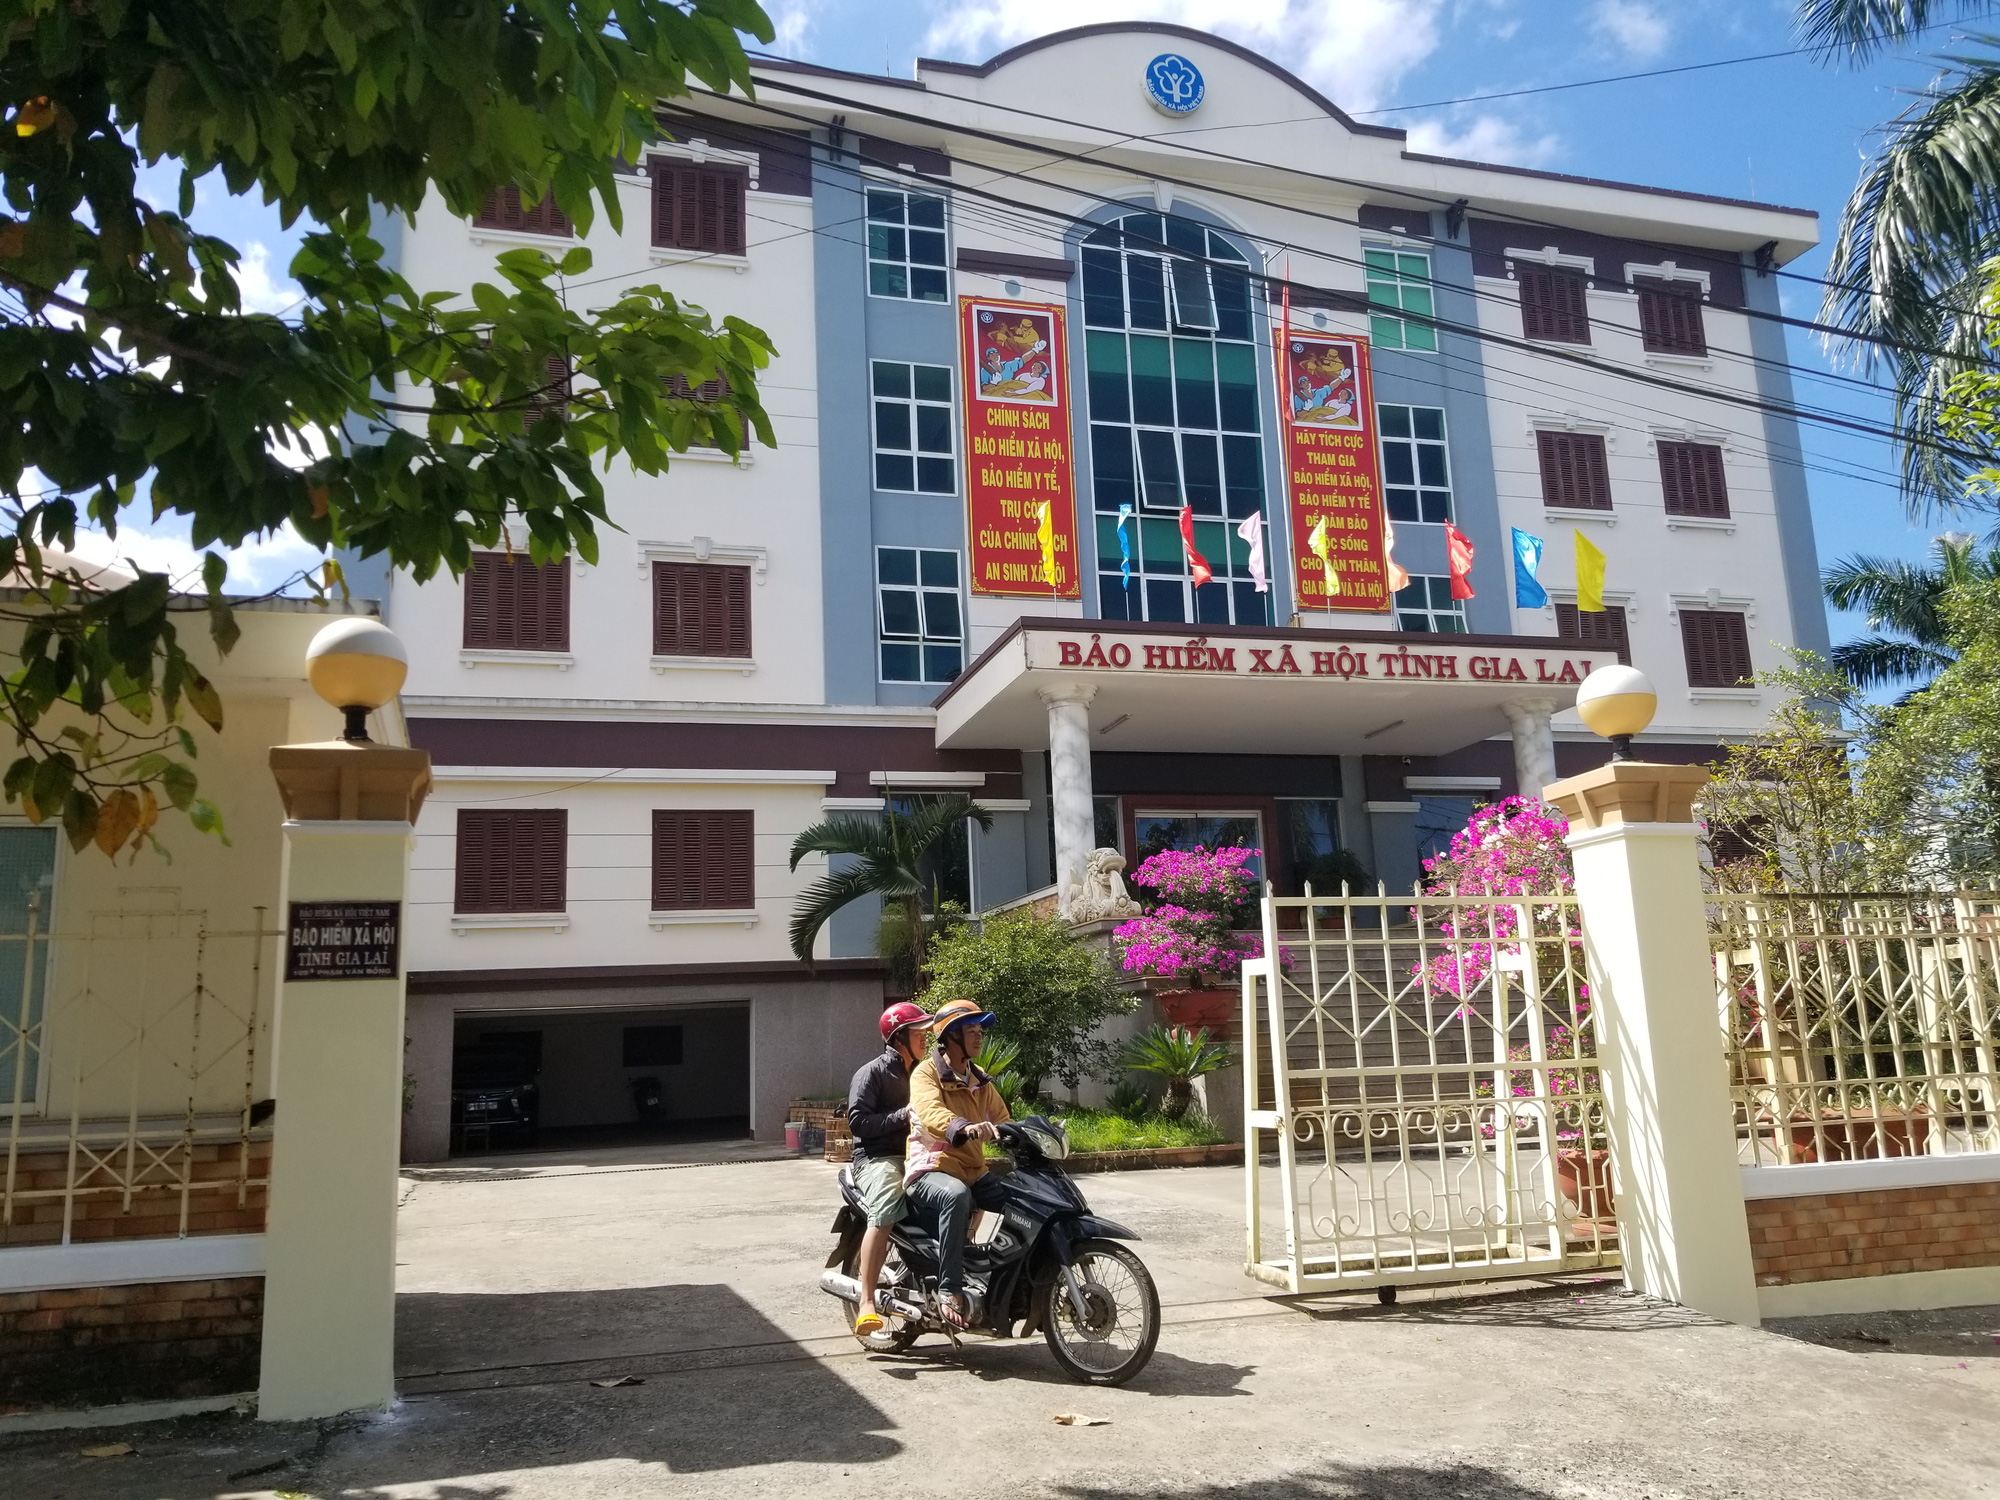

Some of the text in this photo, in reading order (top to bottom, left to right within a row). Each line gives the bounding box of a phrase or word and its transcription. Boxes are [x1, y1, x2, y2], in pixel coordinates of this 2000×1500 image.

[987, 404, 1050, 430] CHÍNH SÁCH
[974, 431, 1064, 464] BẢO HIỂM XÃ HỘI,
[1296, 429, 1364, 452] HÃY TÍCH CỰC
[1306, 452, 1356, 468] THAM GIA
[982, 462, 1060, 494] BẢO HIỂM Y TẾ,
[1294, 468, 1372, 492] BẢO HIỂM XÃ HỘI,
[1298, 488, 1370, 510] BẢO HIỂM Y TẾ
[1000, 500, 1020, 524] TRỤ
[1306, 509, 1320, 528] ĐỂ
[1347, 513, 1368, 530] BẢO
[980, 524, 1002, 548] CỦA
[1004, 528, 1037, 550] CHÍNH
[1340, 534, 1368, 552] SỐNG
[986, 562, 1000, 580] AN
[1003, 563, 1028, 582] SINH
[1030, 560, 1044, 582] XÃ
[1300, 557, 1322, 570] CHO
[1348, 558, 1380, 576] THÂN,
[1302, 580, 1317, 595] GIA
[1341, 578, 1353, 596] VÀ
[1354, 578, 1366, 597] XÃ
[1368, 580, 1383, 602] HỘI
[1058, 634, 1592, 682] BẢO HIỂM XÃ HỘI TỈNH GIA LAI
[292, 921, 318, 946] BẢO
[320, 920, 351, 946] HIỂM
[354, 922, 370, 945] XÃ
[298, 948, 388, 966] TỈNH GIA LAI
[1011, 1212, 1032, 1230] YAMAHA
